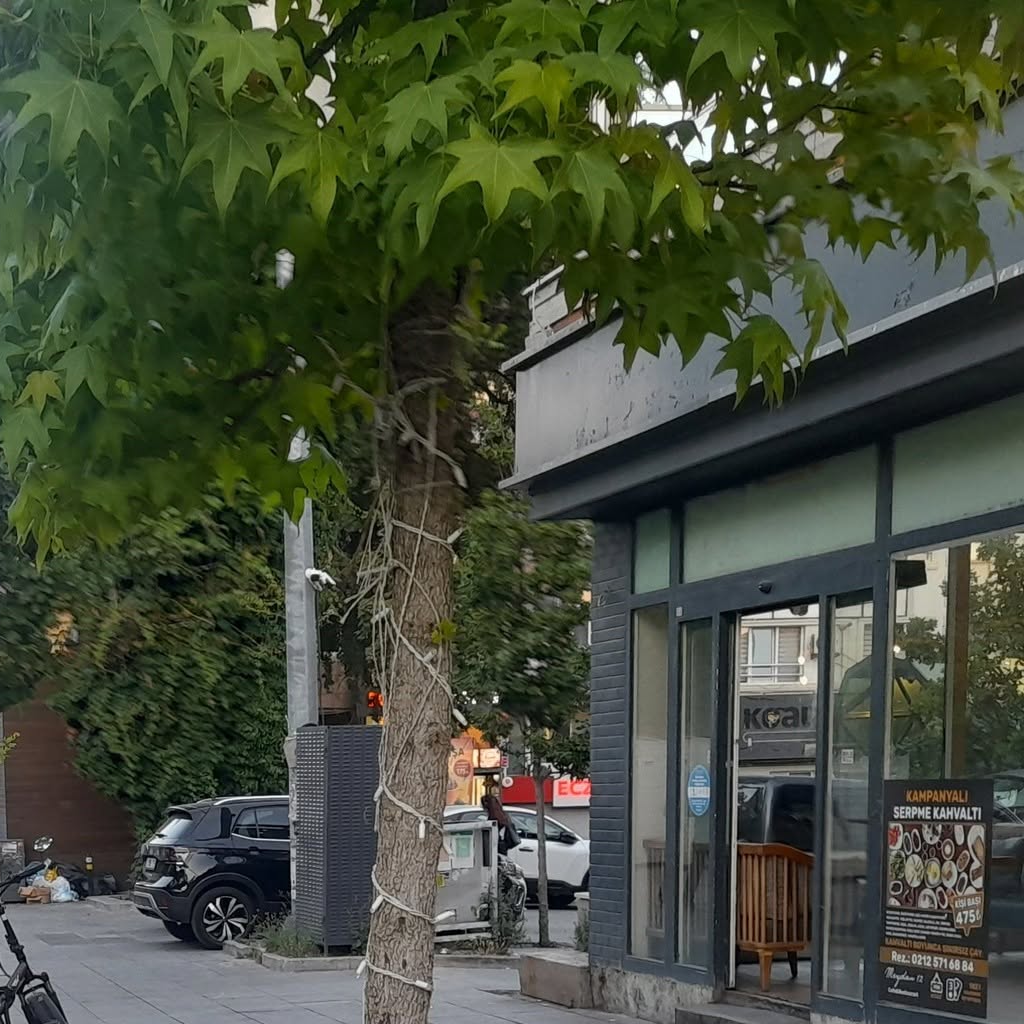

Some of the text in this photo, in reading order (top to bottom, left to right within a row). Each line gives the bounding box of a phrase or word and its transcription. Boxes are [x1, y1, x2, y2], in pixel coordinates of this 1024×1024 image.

[906, 789, 968, 803] KAMPANYALI
[893, 805, 982, 820] SERPME KAHVALTI
[912, 953, 932, 966] 0212
[933, 956, 948, 968] 571
[949, 959, 960, 970] 68
[962, 960, 974, 973] 84
